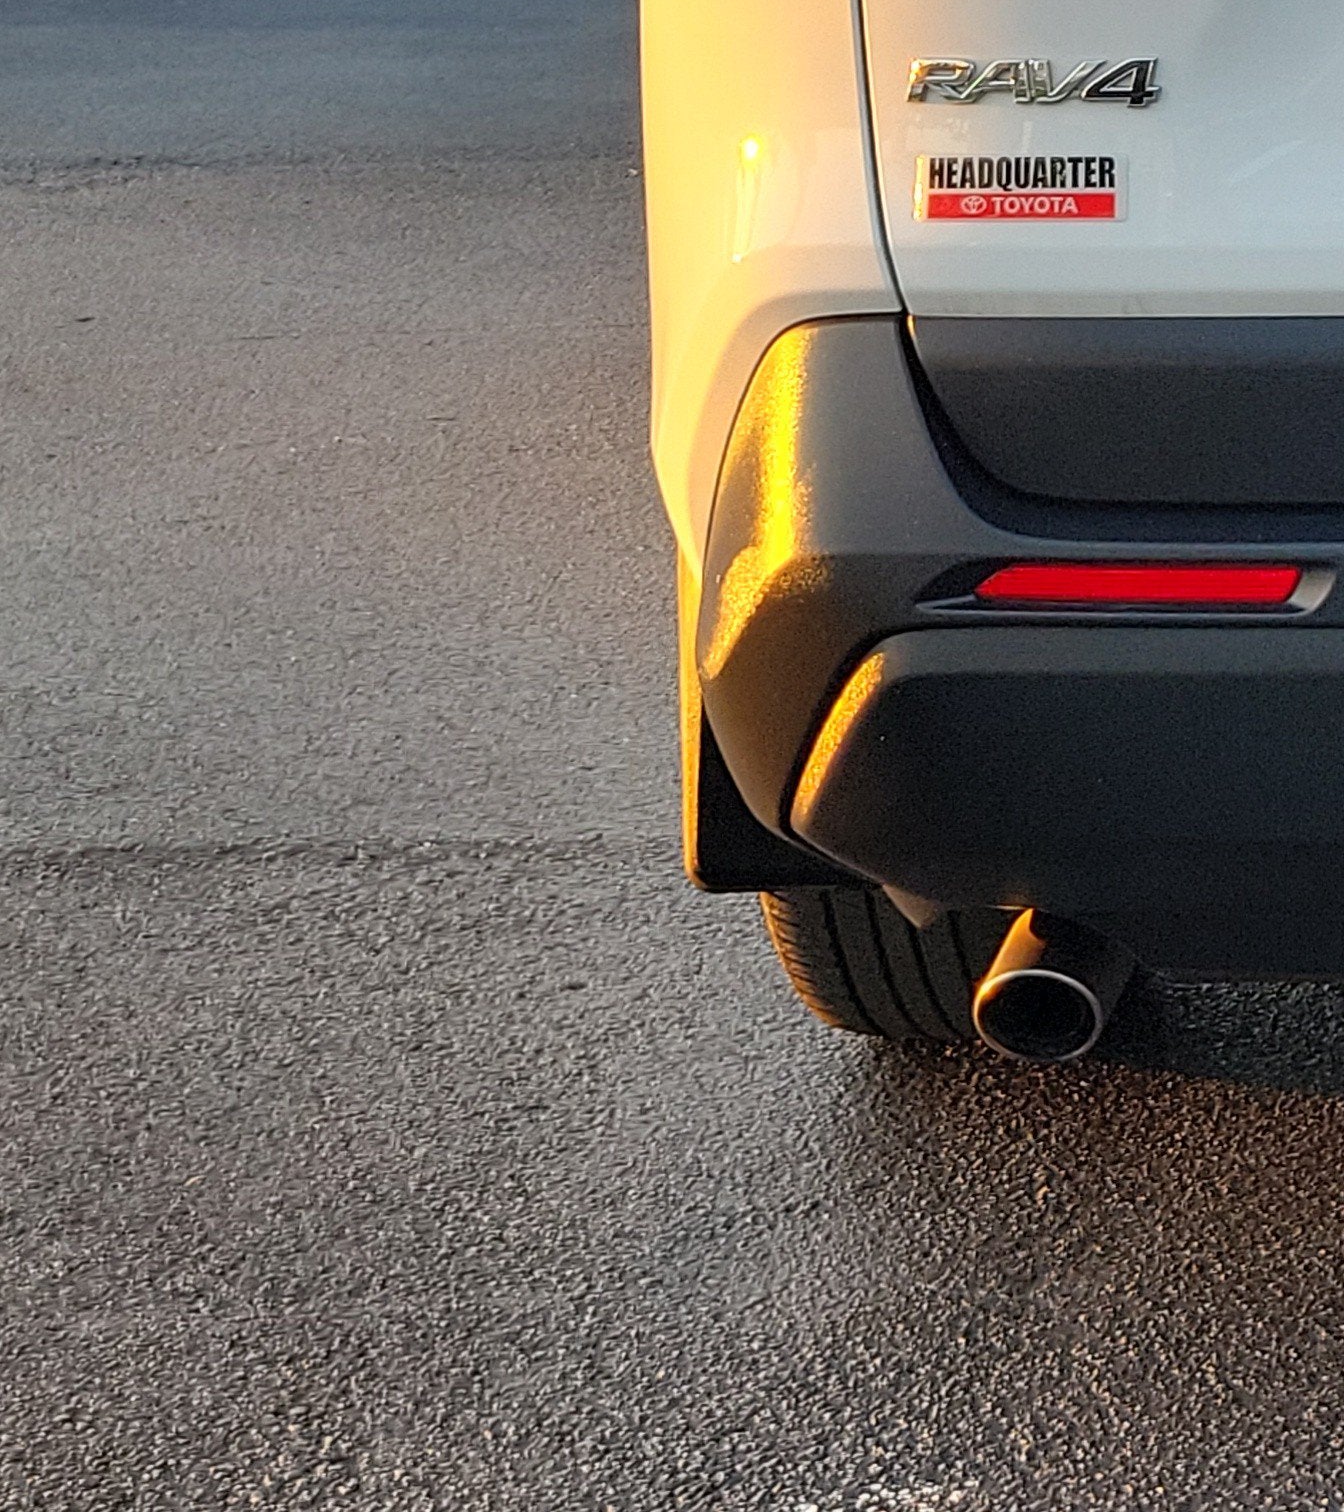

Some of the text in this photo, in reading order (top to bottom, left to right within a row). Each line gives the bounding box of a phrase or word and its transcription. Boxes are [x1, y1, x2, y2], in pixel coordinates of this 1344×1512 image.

[907, 56, 1162, 108] RAV4
[928, 156, 1115, 191] HEADQUARTER
[991, 196, 1078, 215] TOYOTA
